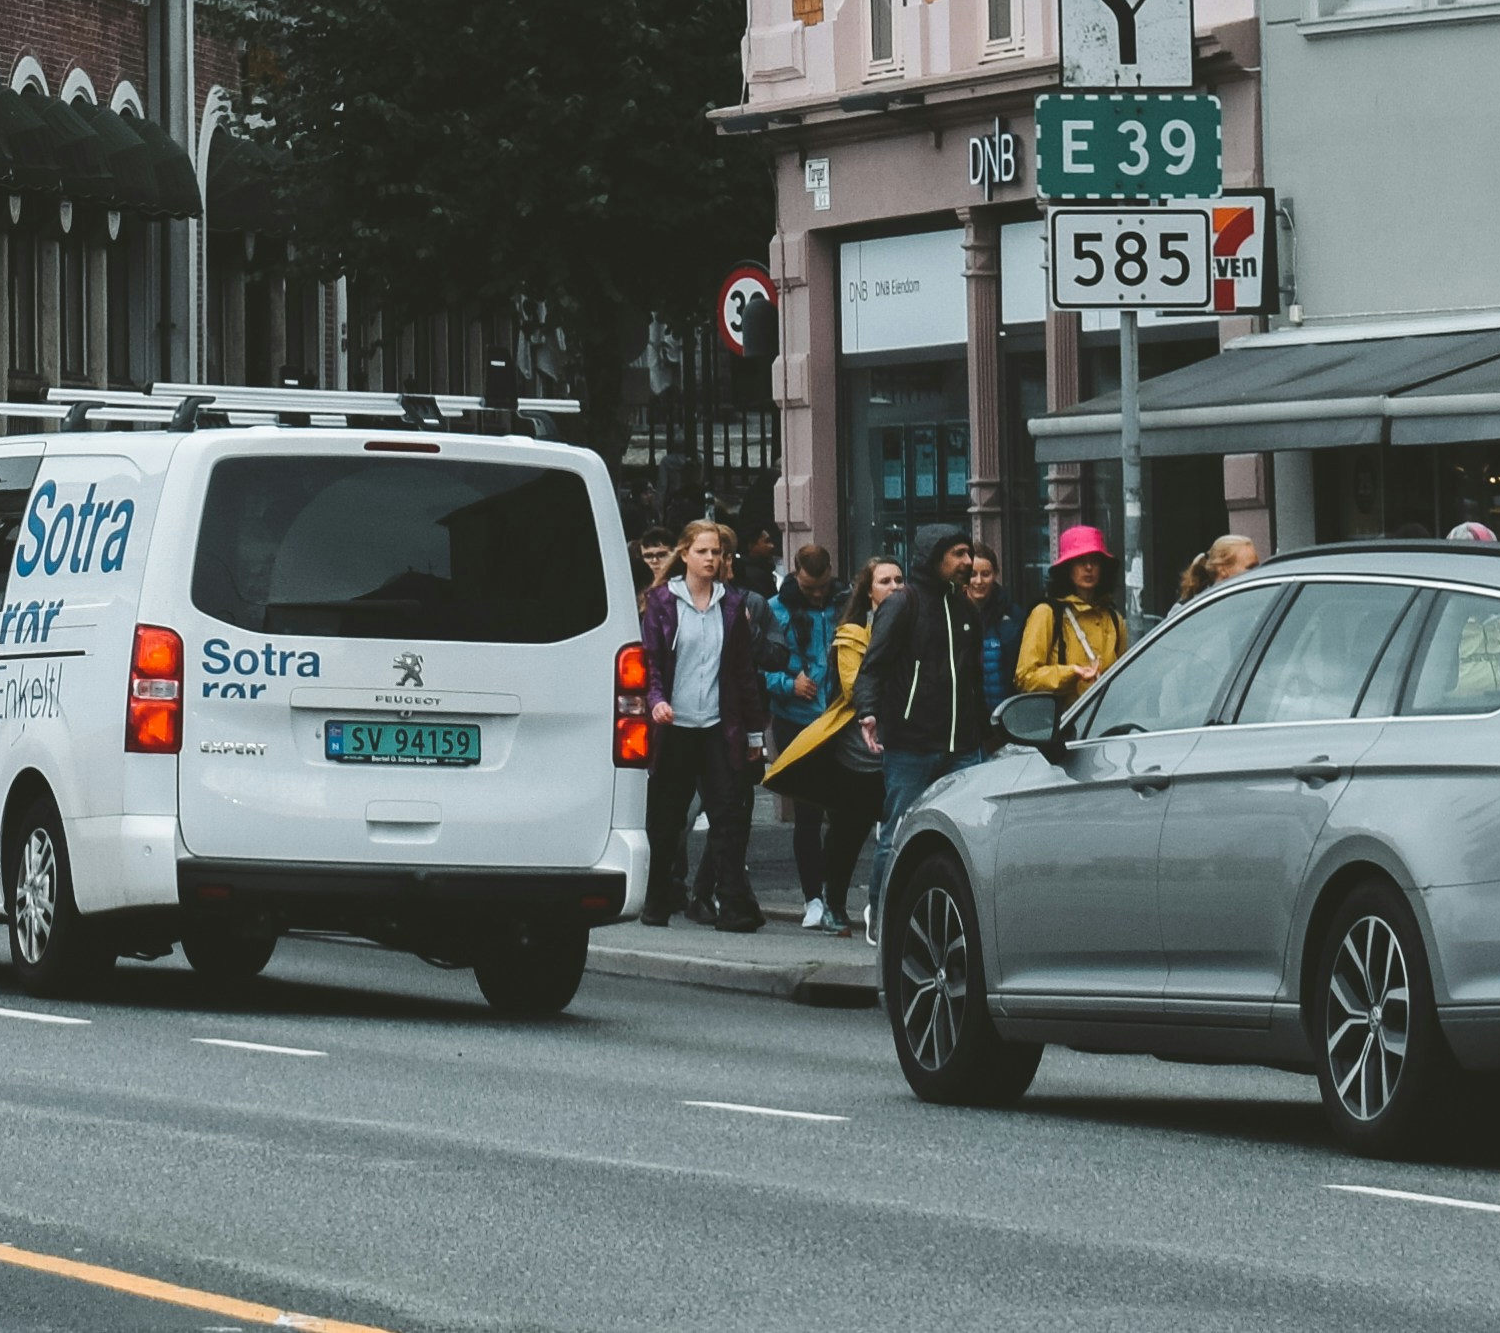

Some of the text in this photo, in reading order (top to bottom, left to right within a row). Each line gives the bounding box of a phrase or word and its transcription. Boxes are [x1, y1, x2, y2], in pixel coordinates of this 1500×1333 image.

[969, 116, 1016, 202] DNB
[1062, 119, 1196, 176] E 39
[1073, 230, 1191, 287] 585
[875, 280, 890, 297] DNB
[729, 289, 766, 333] 3
[15, 478, 135, 578] Sotra
[201, 638, 321, 678] Sotra
[375, 694, 442, 707] PEUGEOT
[200, 741, 268, 757] EXPERT
[351, 726, 471, 757] SV 94159
